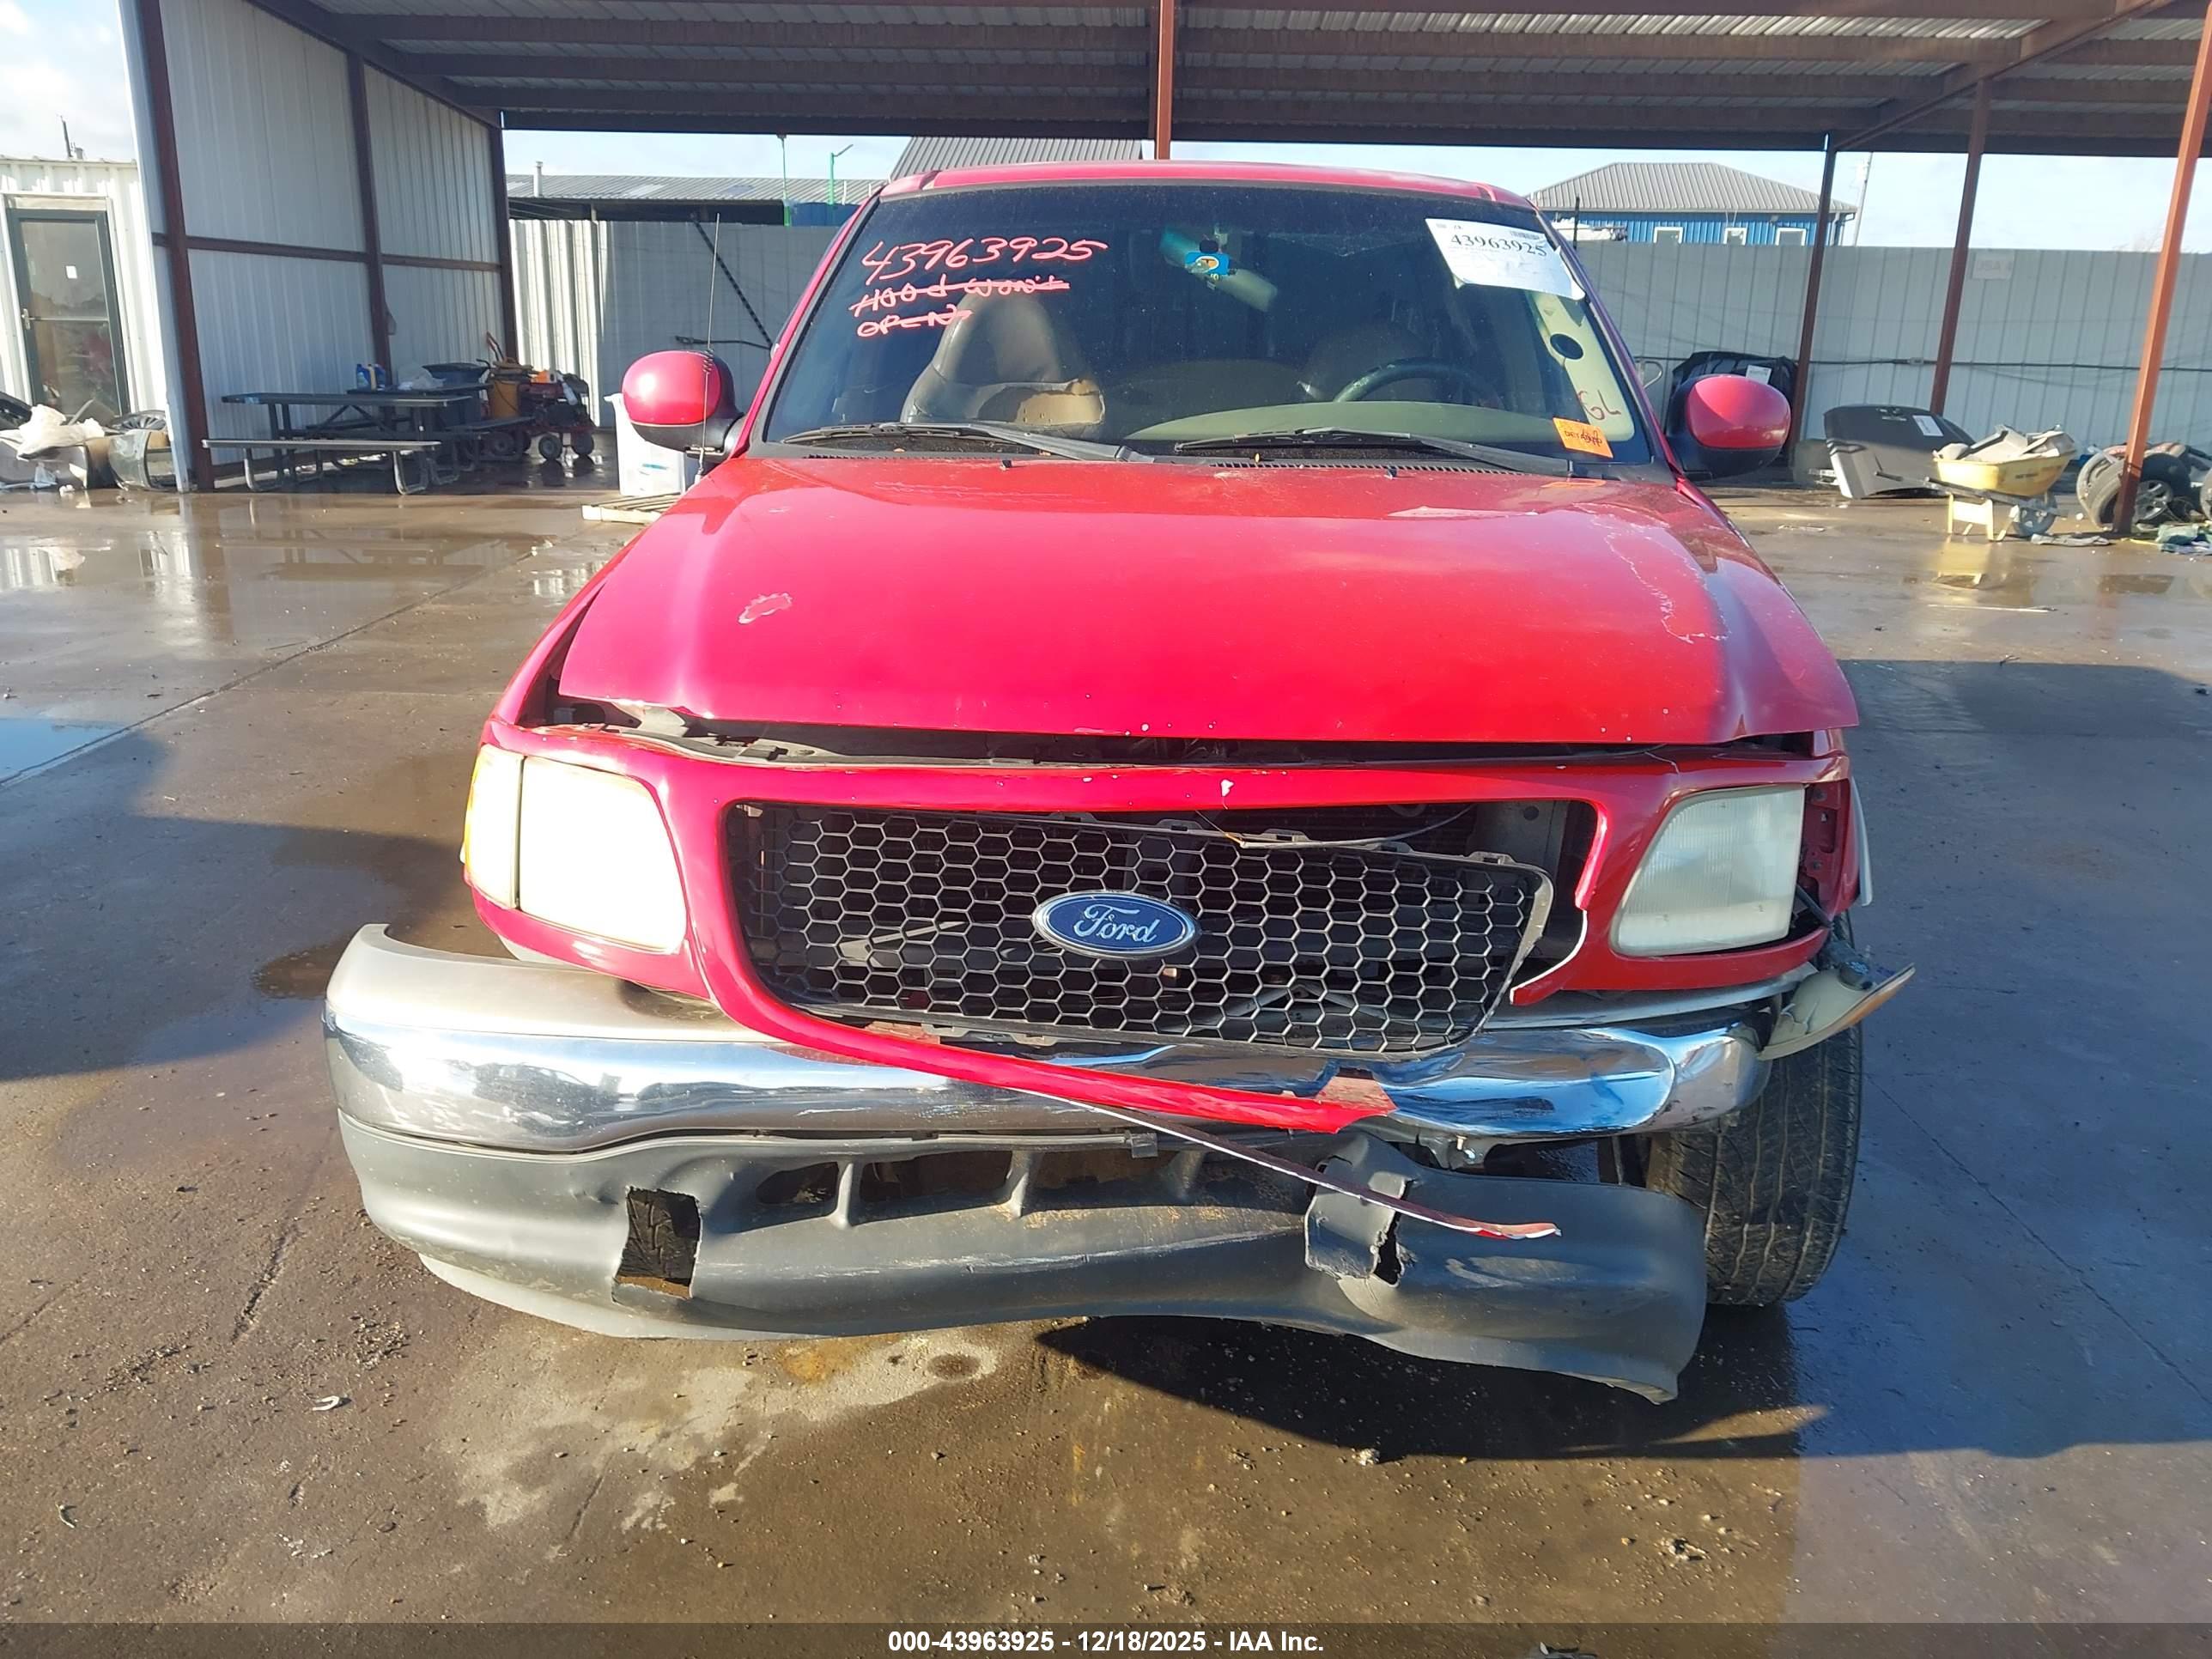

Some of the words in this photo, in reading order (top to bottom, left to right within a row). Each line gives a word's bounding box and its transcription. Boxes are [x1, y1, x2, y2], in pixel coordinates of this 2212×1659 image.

[861, 237, 1109, 285] 43963925
[1450, 234, 1547, 257] 43963925
[1073, 903, 1161, 943] Ford
